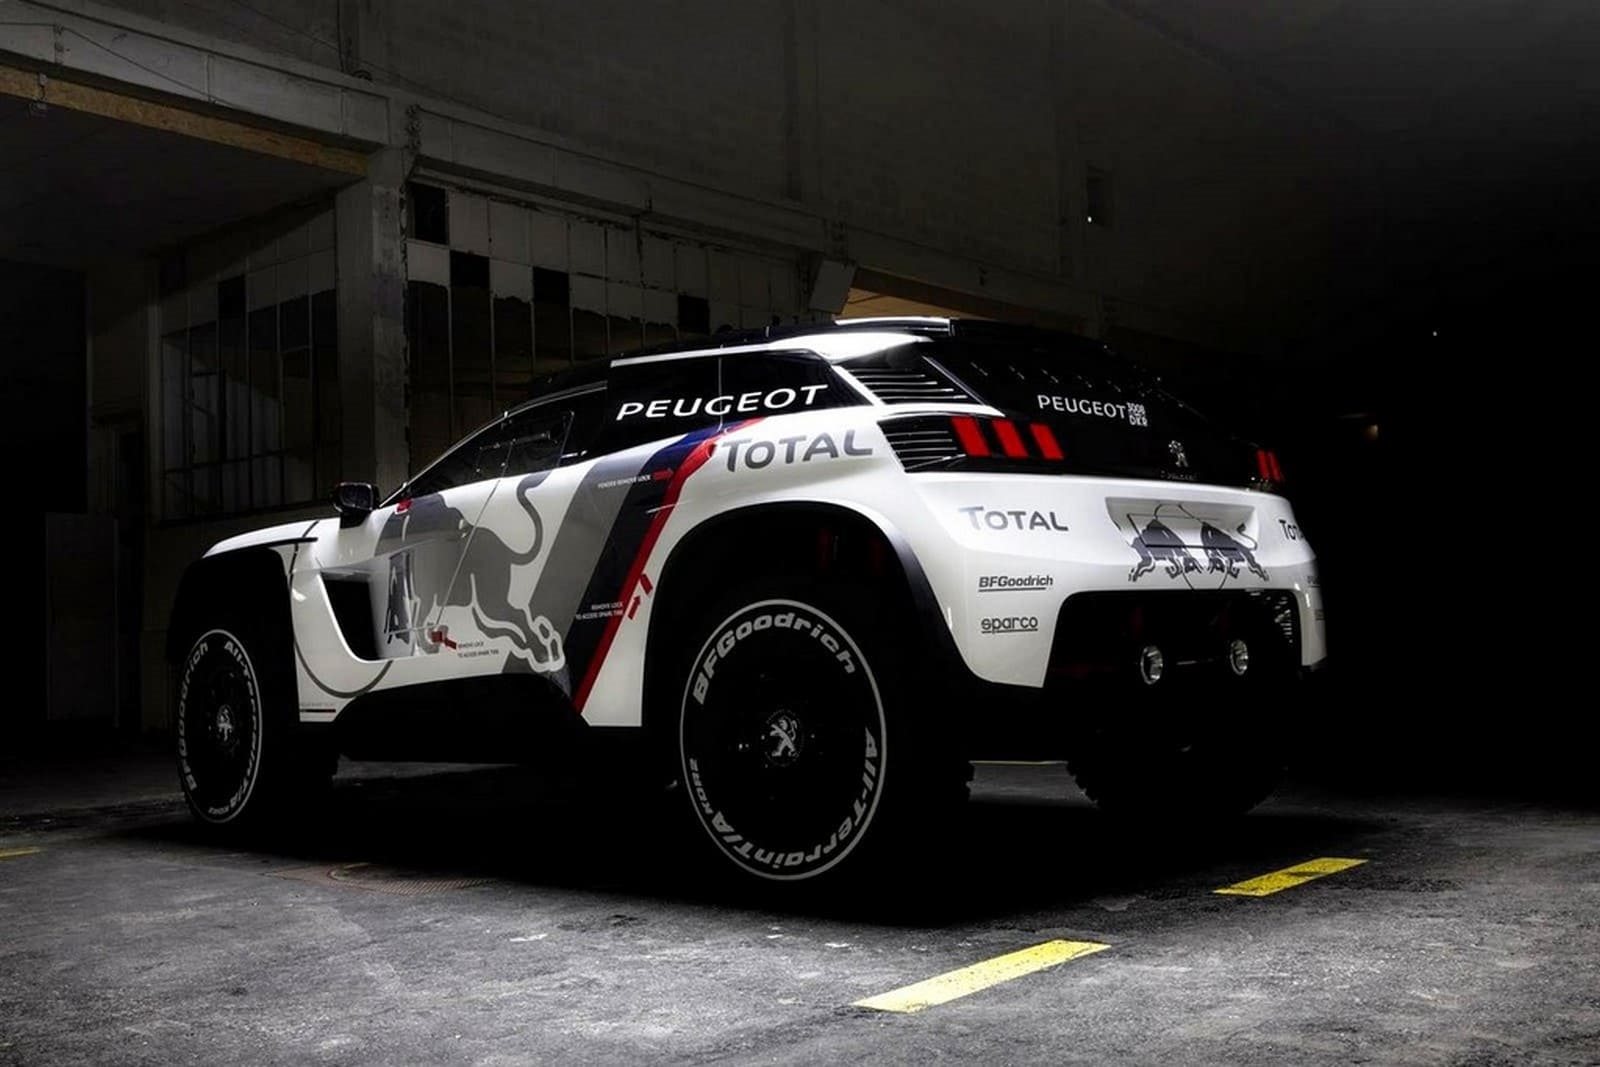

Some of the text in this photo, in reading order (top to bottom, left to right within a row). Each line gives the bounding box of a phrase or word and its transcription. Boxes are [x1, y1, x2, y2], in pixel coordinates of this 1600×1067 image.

[615, 384, 829, 421] PEUGEOT
[1037, 394, 1126, 419] PEUGEOT
[722, 429, 873, 472] TOTAL
[959, 505, 1069, 531] TOTAL
[979, 574, 1053, 589] BFGoodrich
[981, 616, 1038, 634] sparco
[692, 612, 855, 704] BFGoodrich
